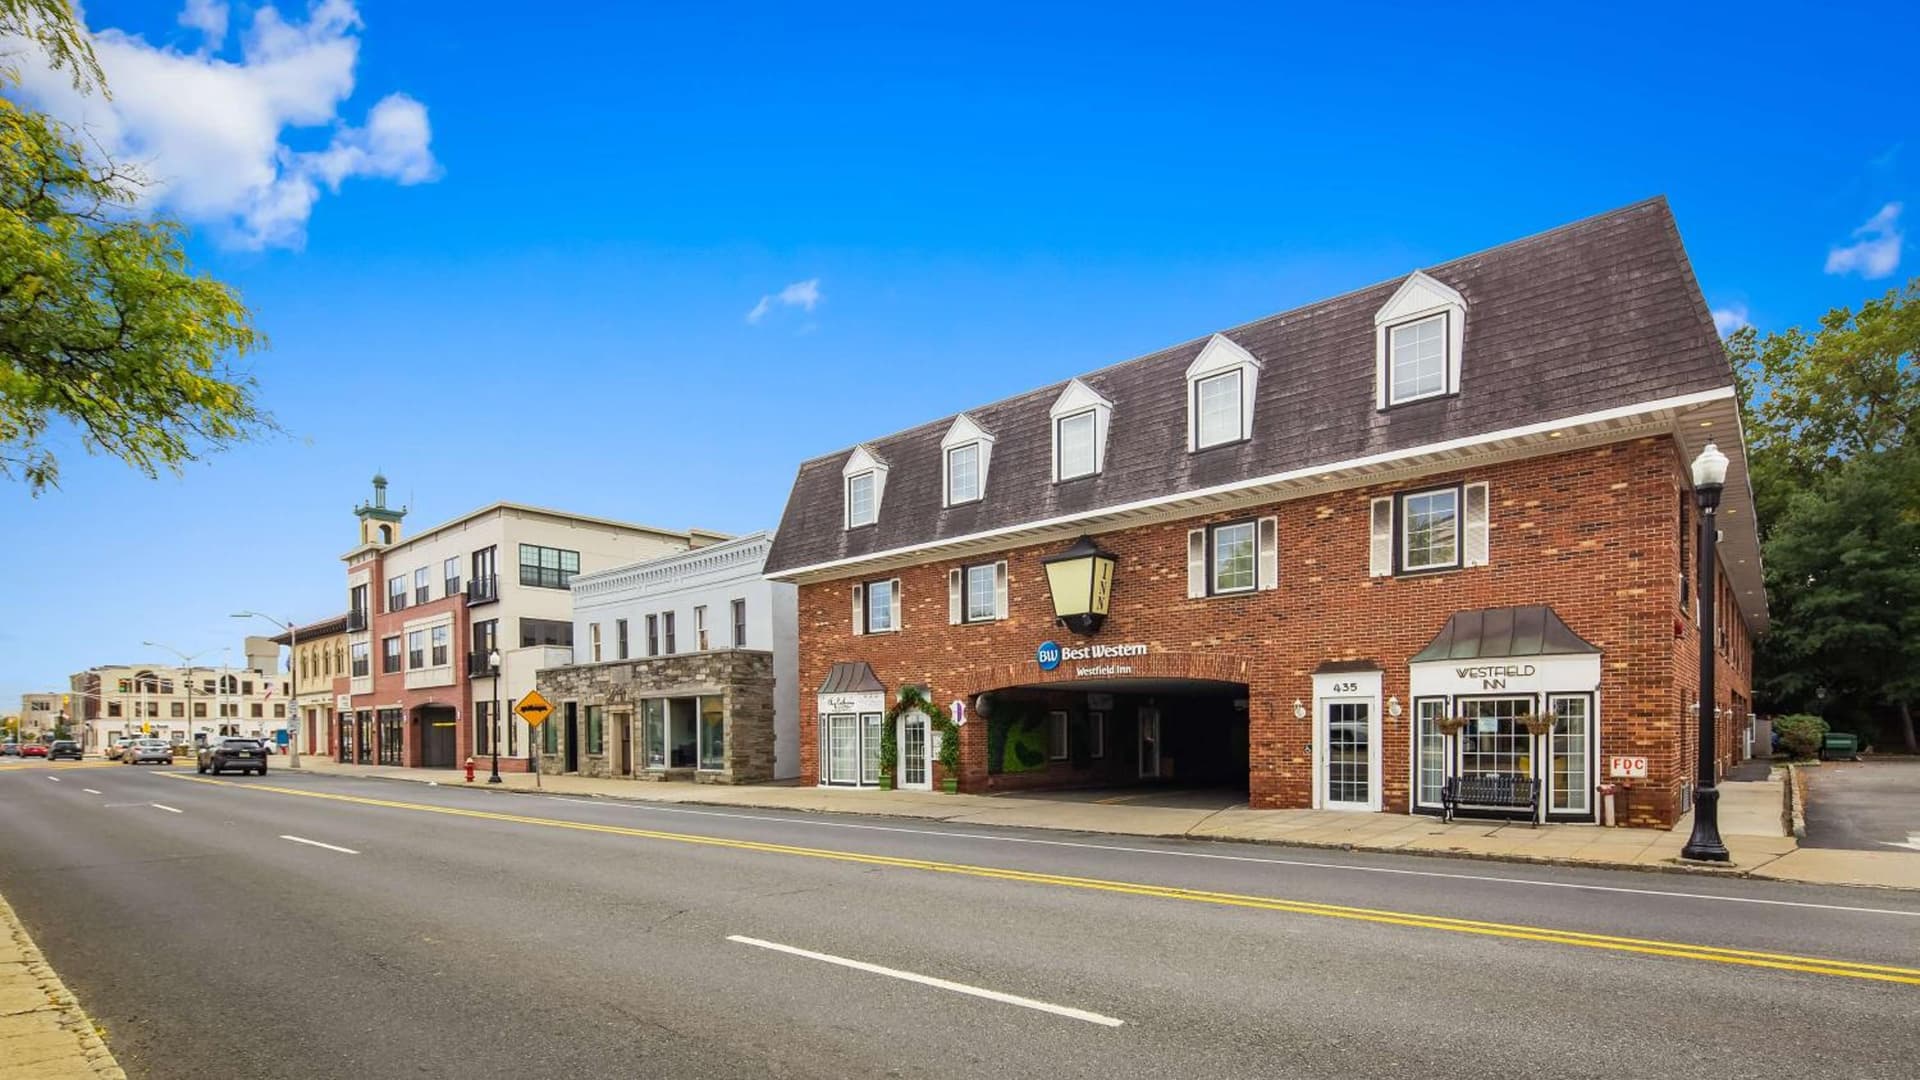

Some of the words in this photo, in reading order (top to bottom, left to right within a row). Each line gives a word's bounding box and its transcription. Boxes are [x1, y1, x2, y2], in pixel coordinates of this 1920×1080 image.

[1039, 650, 1058, 662] BW
[1062, 647, 1090, 660] Best
[1092, 644, 1147, 658] Western
[1077, 665, 1114, 676] Westfield
[1117, 665, 1131, 674] Inn
[1456, 665, 1536, 678] WESTFIELD
[1333, 682, 1358, 692] 435
[1483, 679, 1506, 690] INN
[1614, 759, 1643, 769] FDC
